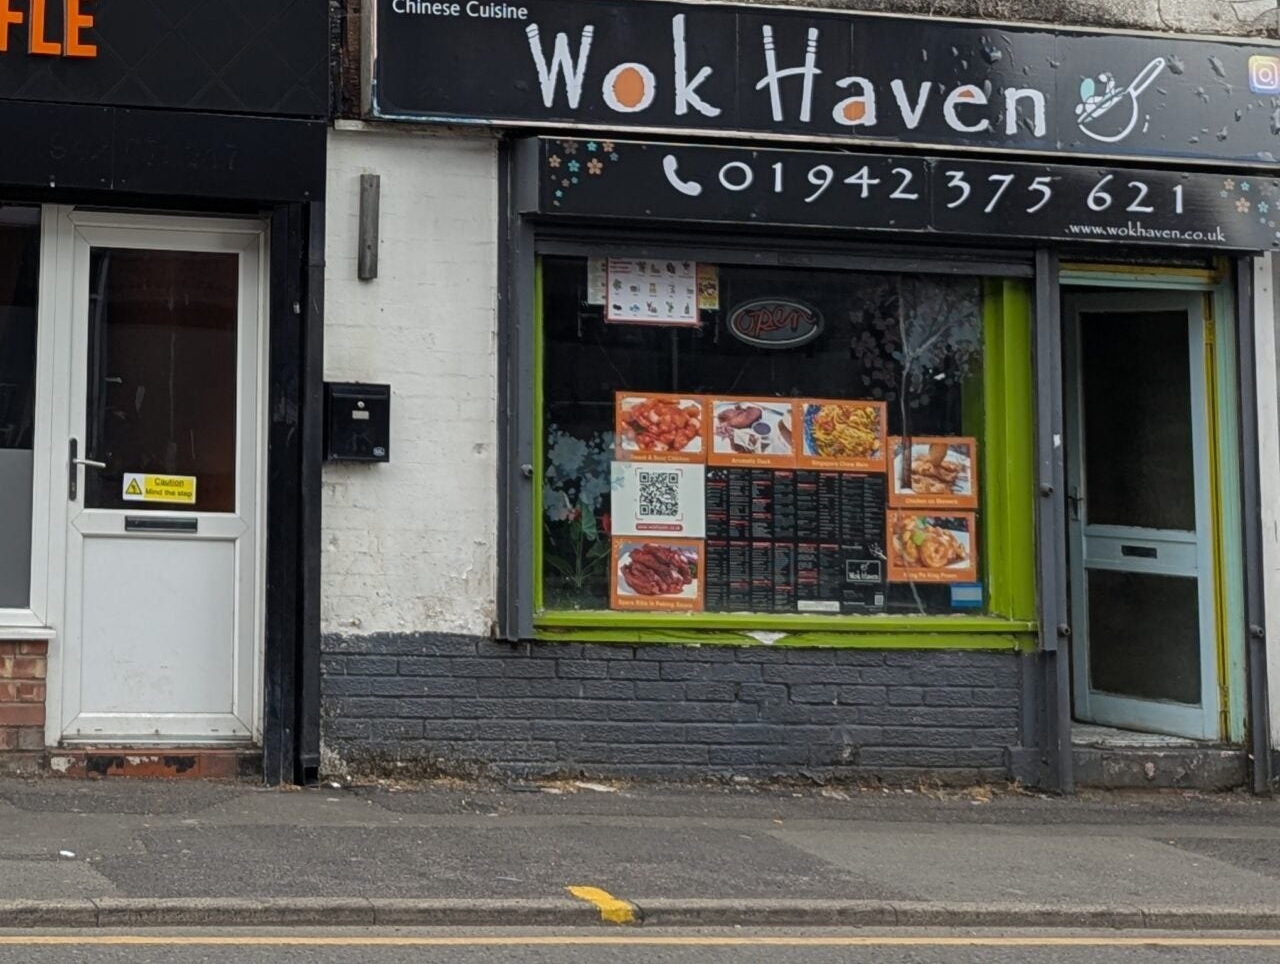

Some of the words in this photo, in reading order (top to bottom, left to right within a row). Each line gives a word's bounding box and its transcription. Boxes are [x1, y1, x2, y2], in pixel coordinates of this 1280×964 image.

[466, 0, 528, 20] Cuisine
[525, 13, 720, 117] Wok
[755, 24, 1048, 138] Haven
[719, 161, 919, 203] 01942
[945, 170, 1052, 214] 375
[1086, 174, 1183, 214] 621
